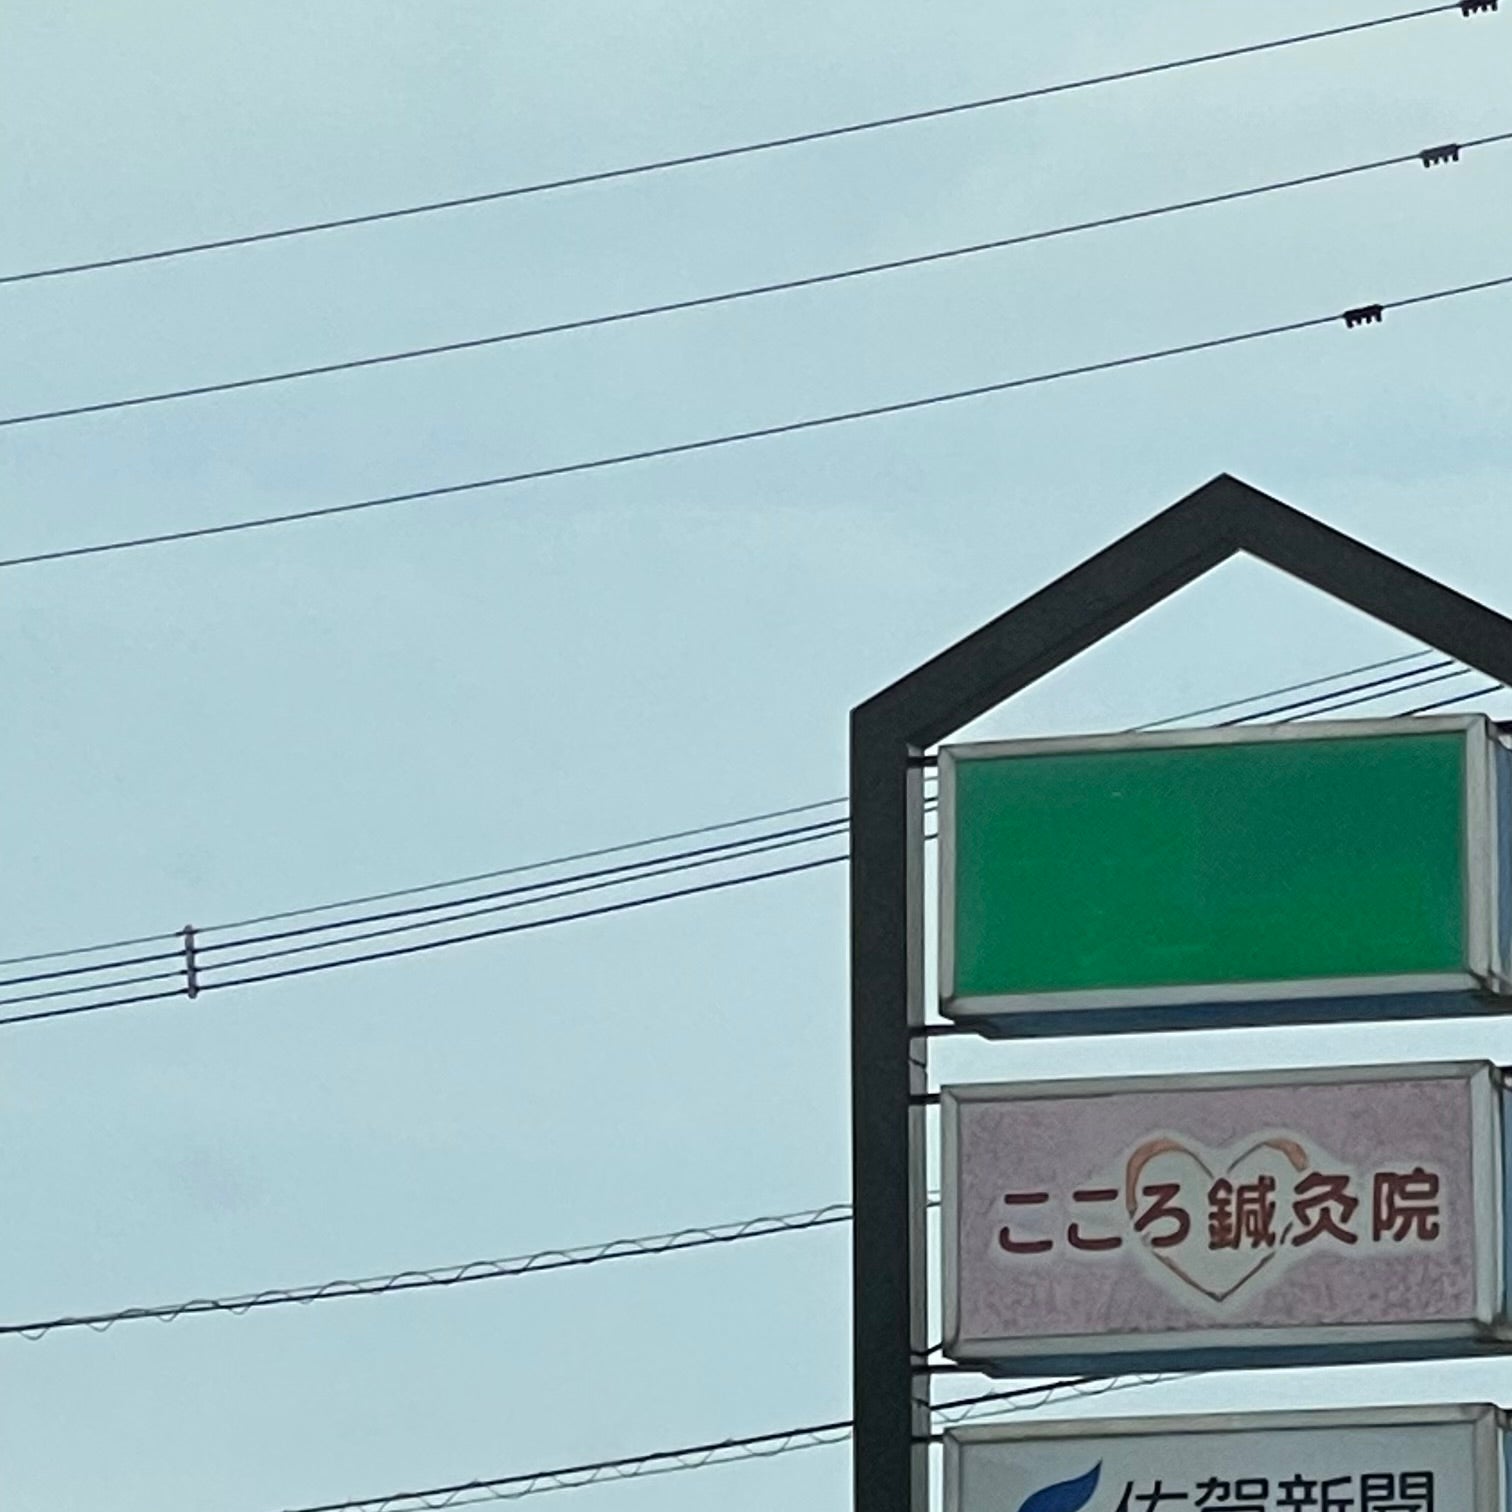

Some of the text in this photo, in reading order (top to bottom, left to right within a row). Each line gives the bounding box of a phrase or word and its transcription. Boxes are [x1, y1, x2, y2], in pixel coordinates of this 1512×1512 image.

[1000, 1167, 1440, 1254] こころ鍼灸院
